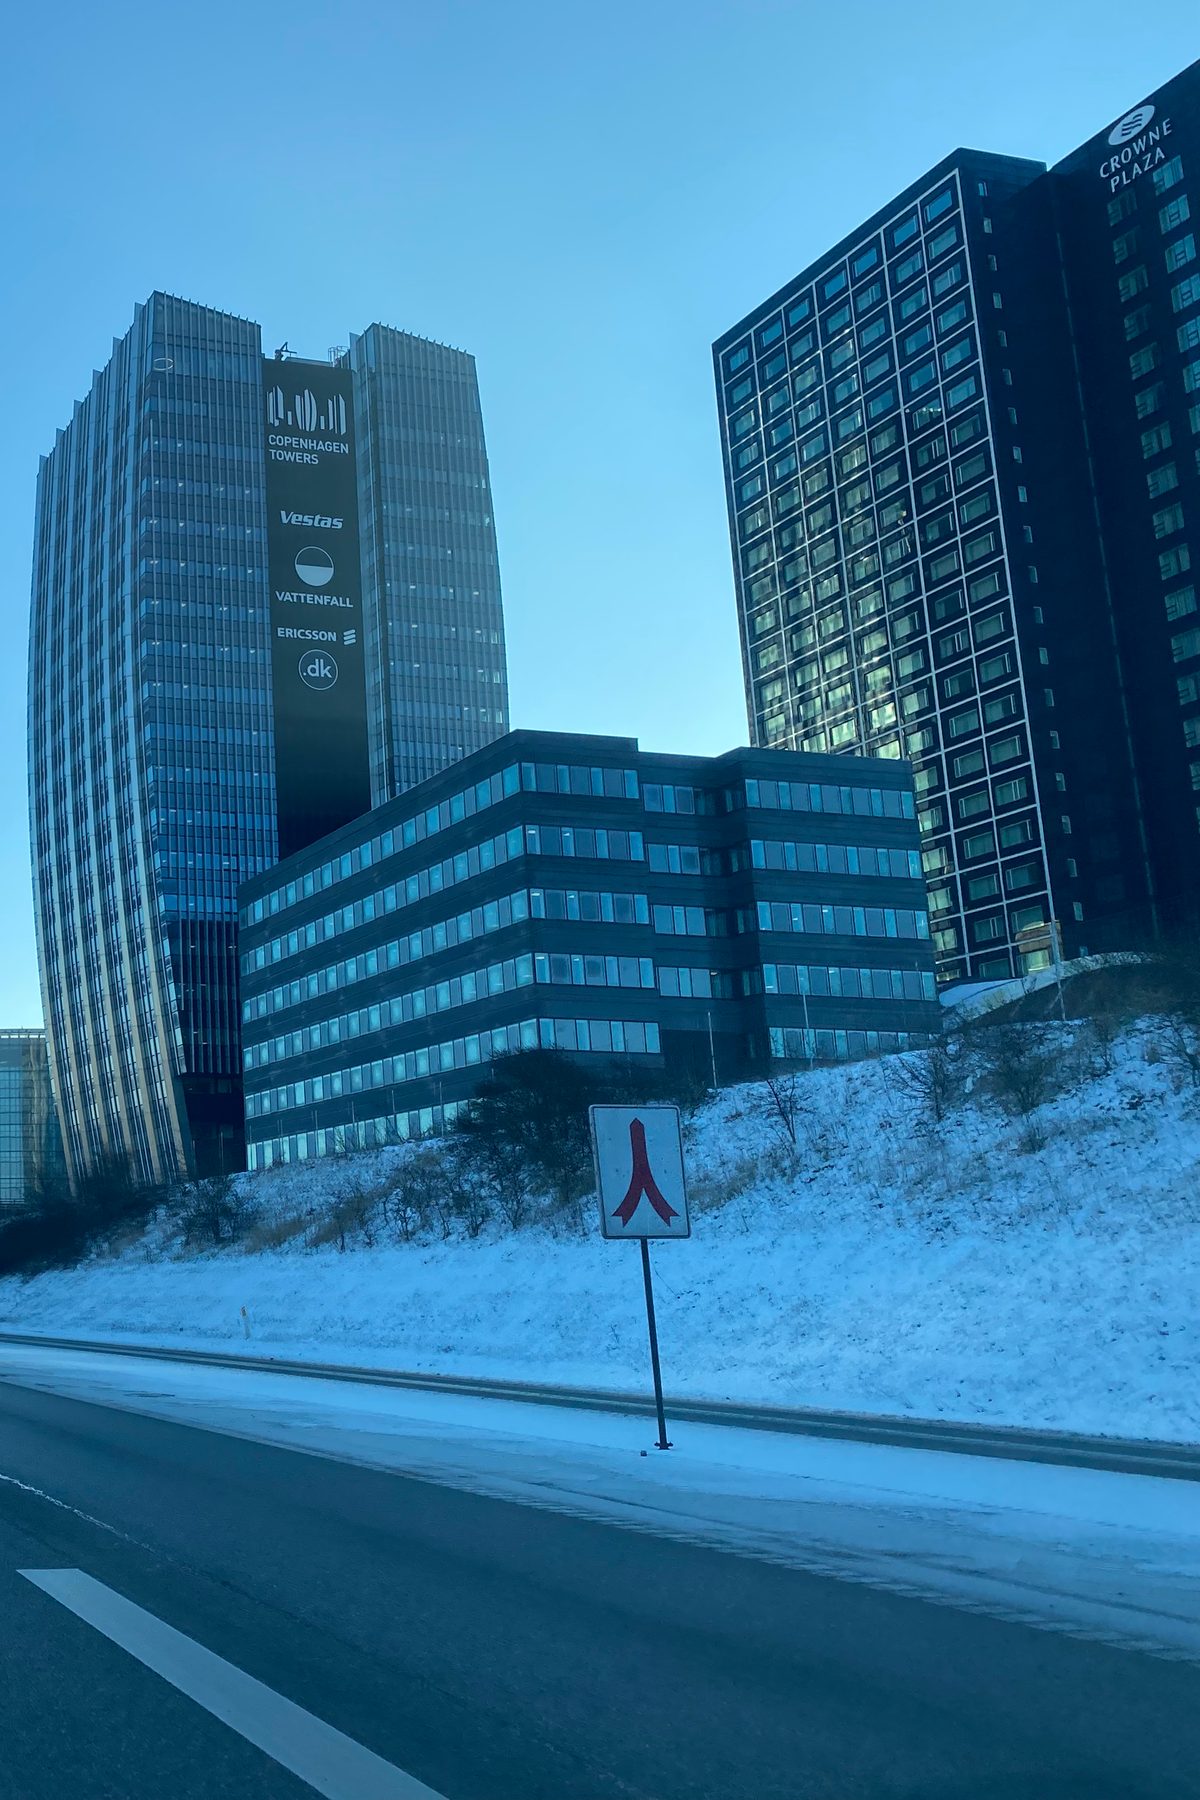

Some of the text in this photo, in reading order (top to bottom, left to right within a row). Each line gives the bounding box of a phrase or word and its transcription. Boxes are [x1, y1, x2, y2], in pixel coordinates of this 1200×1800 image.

[1100, 118, 1172, 178] CROWNE
[1110, 147, 1165, 193] PLAZA
[268, 434, 349, 454] COPENHAGEN
[269, 449, 319, 465] TOWERS
[280, 510, 344, 530] Vestas
[275, 591, 354, 608] VATTENFALL
[277, 627, 337, 642] ERICSSON
